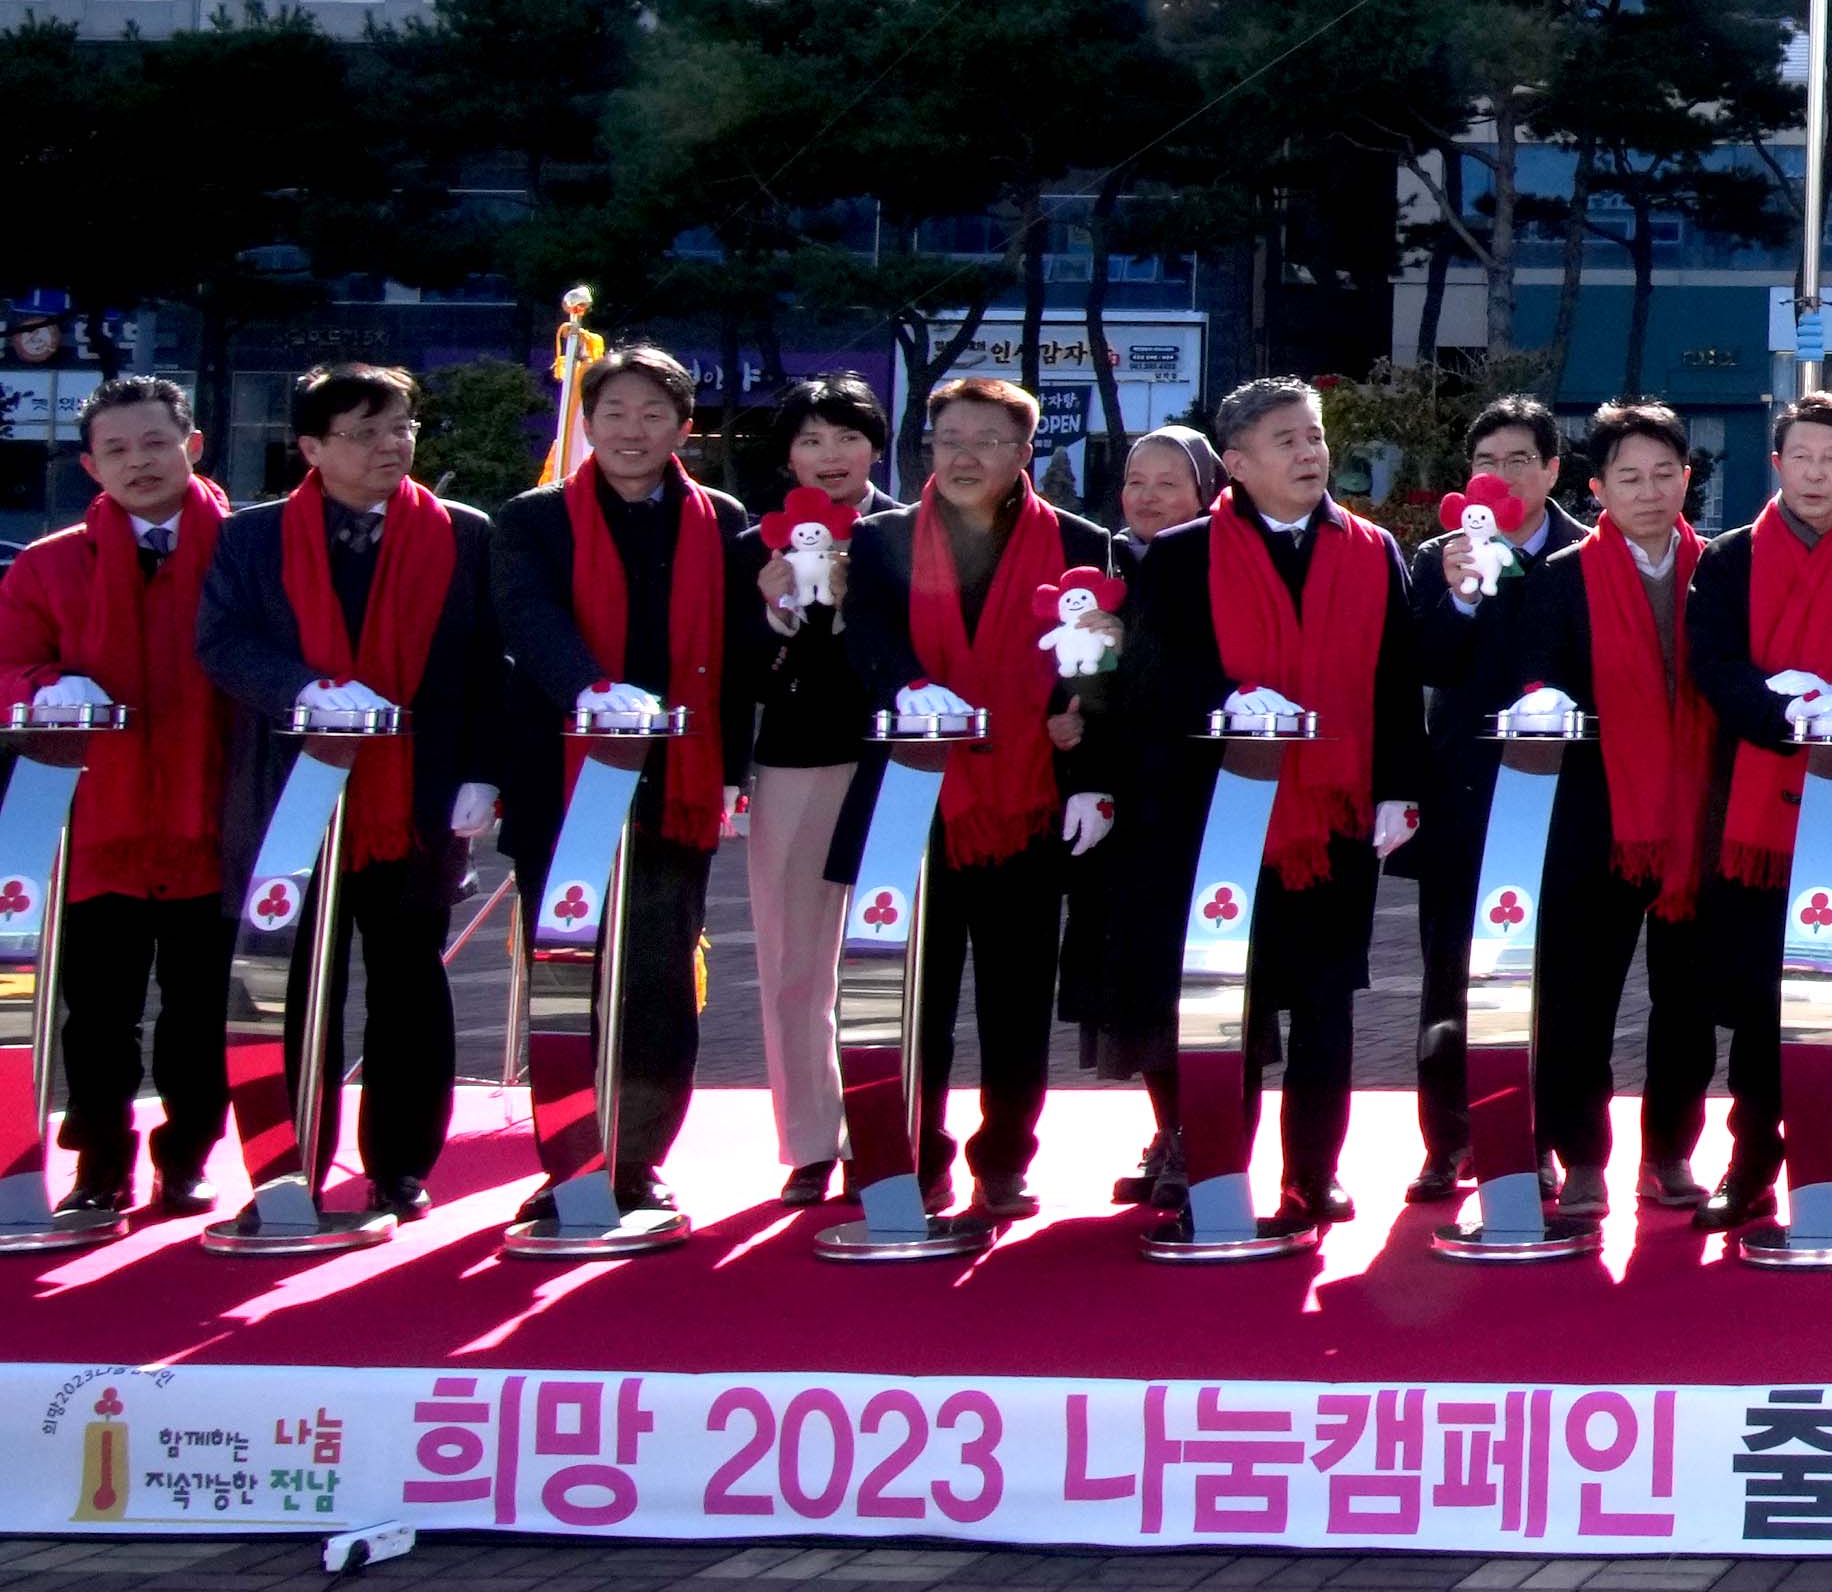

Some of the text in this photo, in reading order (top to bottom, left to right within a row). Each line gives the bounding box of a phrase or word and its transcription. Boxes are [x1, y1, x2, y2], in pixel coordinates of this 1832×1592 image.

[1037, 414, 1081, 434] OPEN
[159, 1408, 343, 1465] 함께하는 나눔
[403, 1376, 653, 1527] 희망
[703, 1387, 1004, 1525] 2023
[1062, 1385, 1676, 1539] 나눔캠페인
[145, 1469, 342, 1513] 지속가능한 전남
